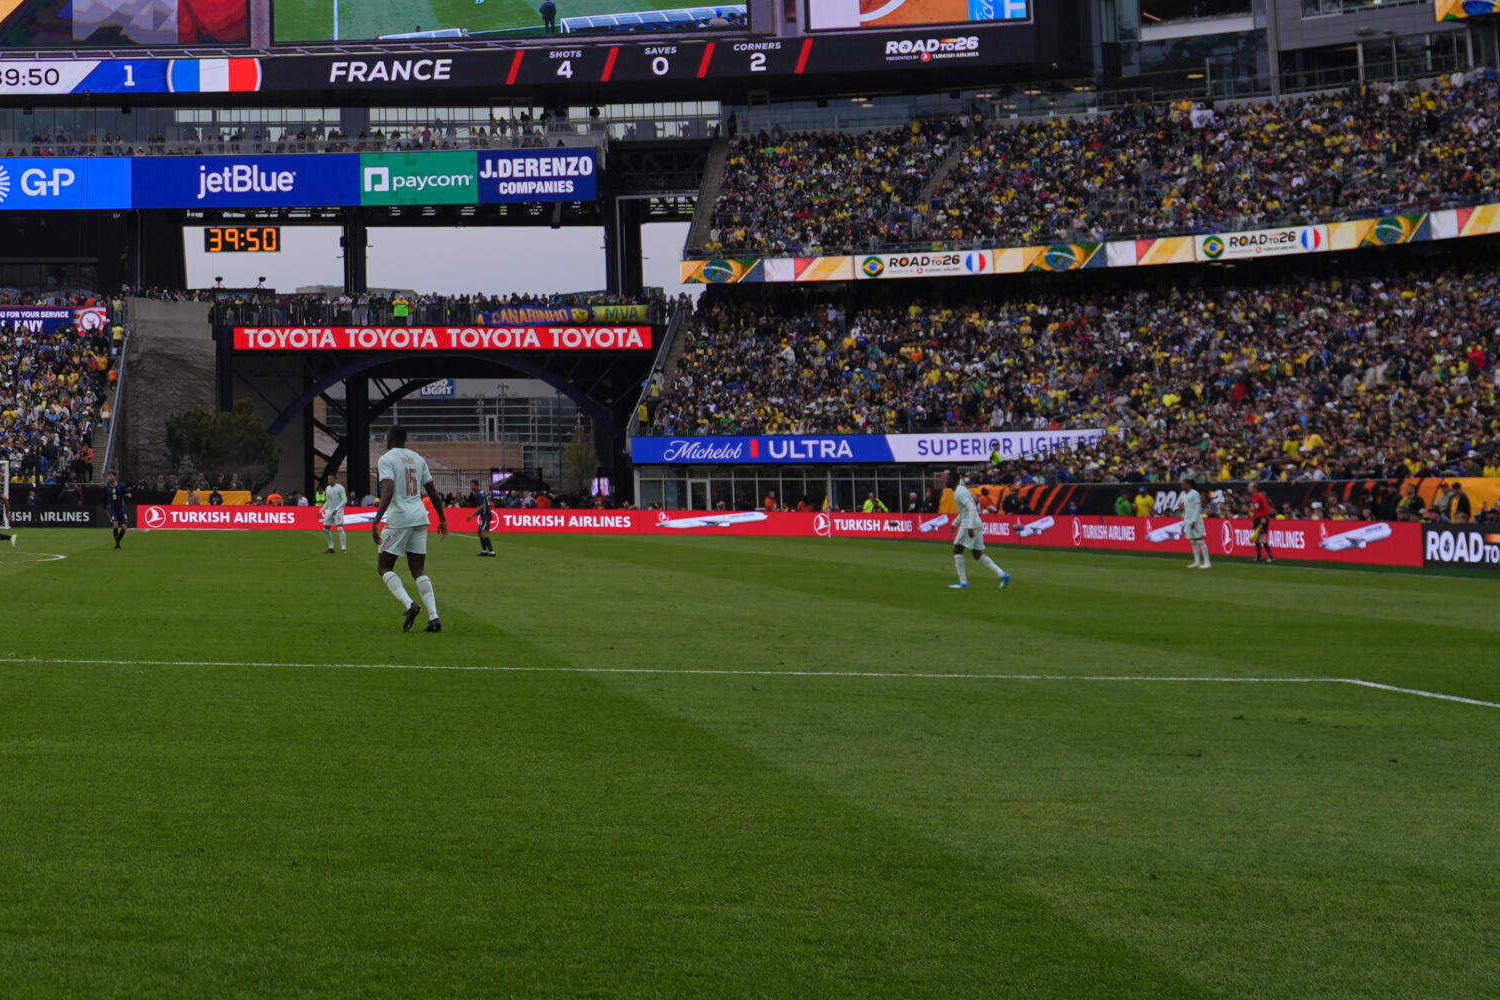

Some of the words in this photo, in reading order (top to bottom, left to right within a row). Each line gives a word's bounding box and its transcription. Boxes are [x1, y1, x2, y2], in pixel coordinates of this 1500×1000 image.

[645, 46, 677, 55] SAVES
[733, 41, 782, 51] CORNERS
[885, 39, 940, 54] ROAD
[940, 43, 955, 51] TO
[954, 36, 979, 51] 26
[549, 50, 582, 59] SHOTS
[750, 53, 766, 71] 2
[123, 65, 135, 86] 1
[329, 58, 452, 84] FRANCE
[556, 60, 573, 79] 4
[652, 57, 669, 76] 0
[479, 156, 594, 179] J.DERENZO
[197, 164, 294, 199] jetBlue
[393, 174, 471, 191] paycom
[499, 180, 574, 195] COMPANIES
[209, 227, 278, 252] 39:50
[1229, 234, 1269, 248] ROAD
[1279, 231, 1297, 242] 26
[889, 256, 931, 268] ROAD
[942, 254, 960, 265] 26
[6, 311, 20, 319] FOR
[20, 311, 40, 319] YOUR
[40, 311, 69, 319] SERVICE
[492, 308, 569, 325] CANARINHO
[244, 329, 337, 349] TOYOTA
[345, 329, 438, 349] TOYOTA
[446, 328, 541, 349] TOYOTA
[548, 328, 643, 348] TOYOTA
[663, 440, 742, 462] Michelob
[768, 440, 853, 459] ULTRA
[917, 436, 1012, 456] SUPERIOR
[405, 468, 418, 497] 15
[170, 511, 230, 523] TURKISH
[234, 512, 295, 523] AIRLINES
[503, 515, 565, 527] TURKISH
[568, 515, 632, 528] AIRLINES
[834, 519, 881, 531] TURKISH
[1082, 524, 1106, 540] TURKISH
[1108, 524, 1136, 541] AIRLINES
[1268, 529, 1305, 549] AIRLINES
[1425, 530, 1482, 563] ROAD
